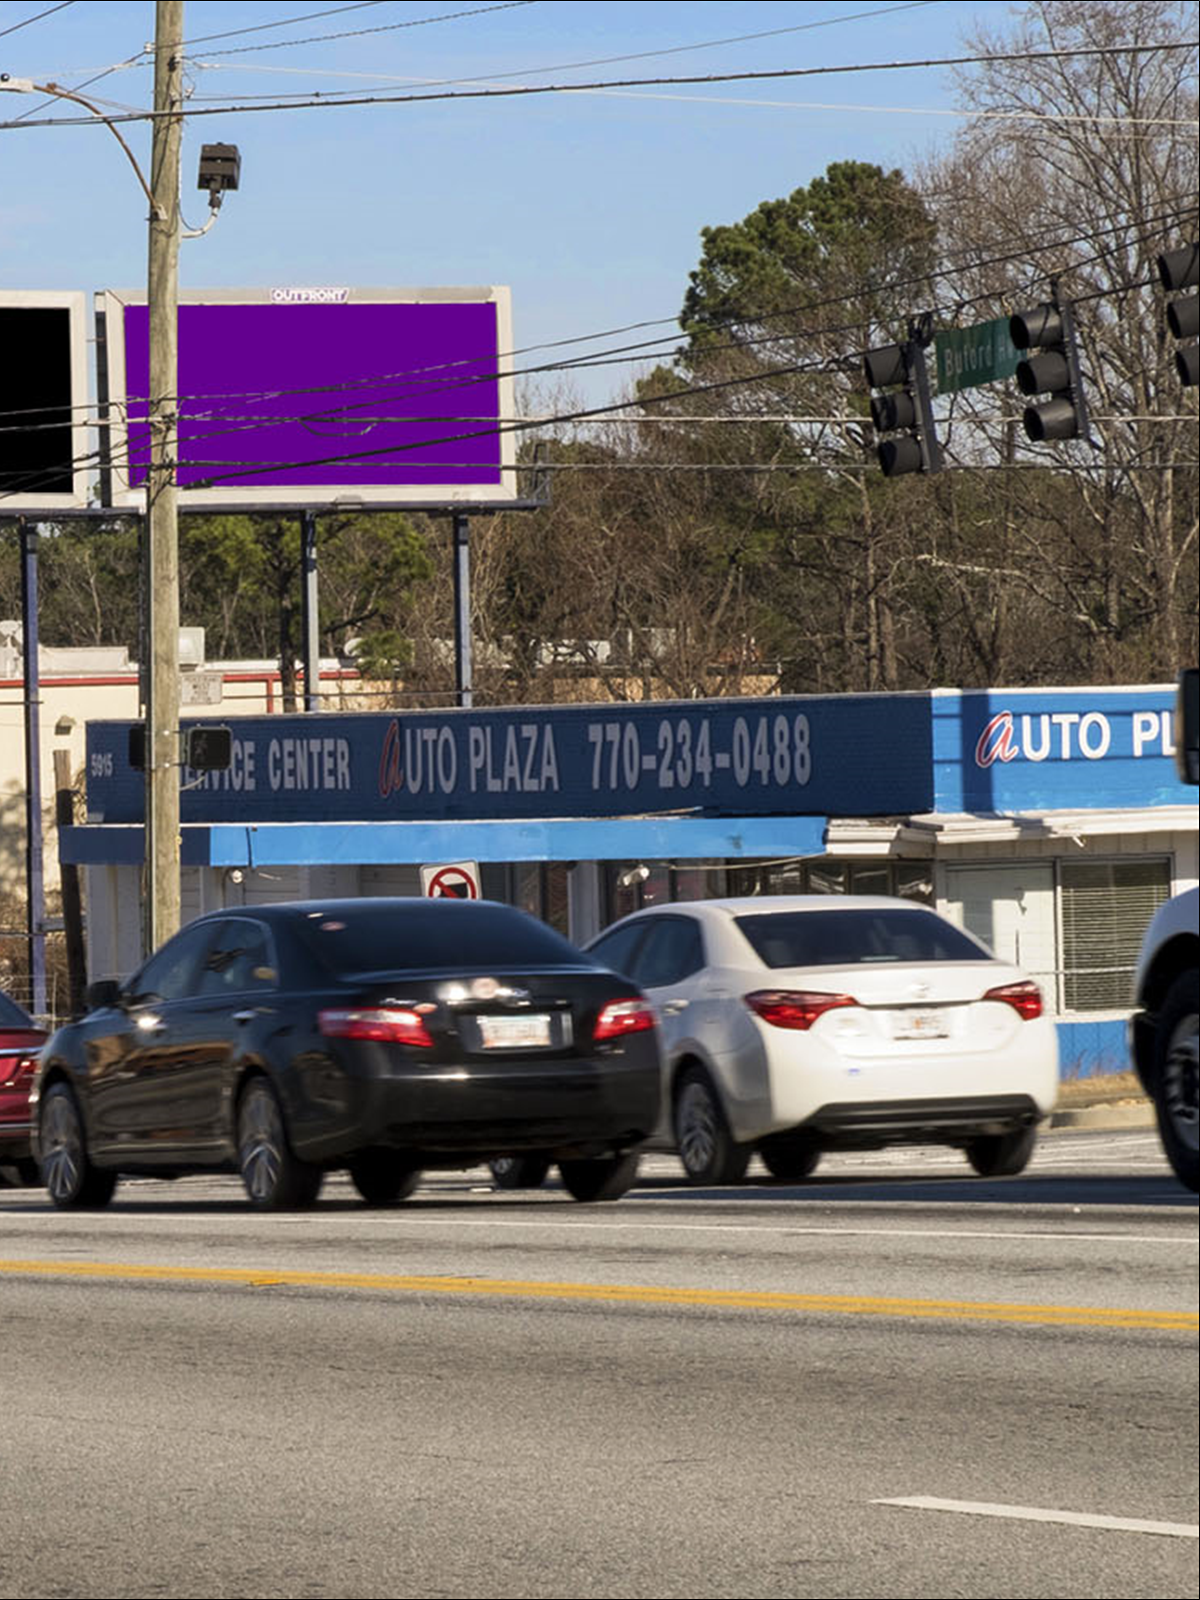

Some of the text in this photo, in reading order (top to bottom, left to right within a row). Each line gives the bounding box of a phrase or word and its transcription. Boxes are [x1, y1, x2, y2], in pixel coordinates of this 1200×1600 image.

[272, 288, 347, 303] OUTFRONT
[944, 340, 993, 377] Buford
[268, 738, 351, 791] CENTER
[468, 723, 560, 793] PLAZA
[588, 713, 812, 790] 770-234-0488
